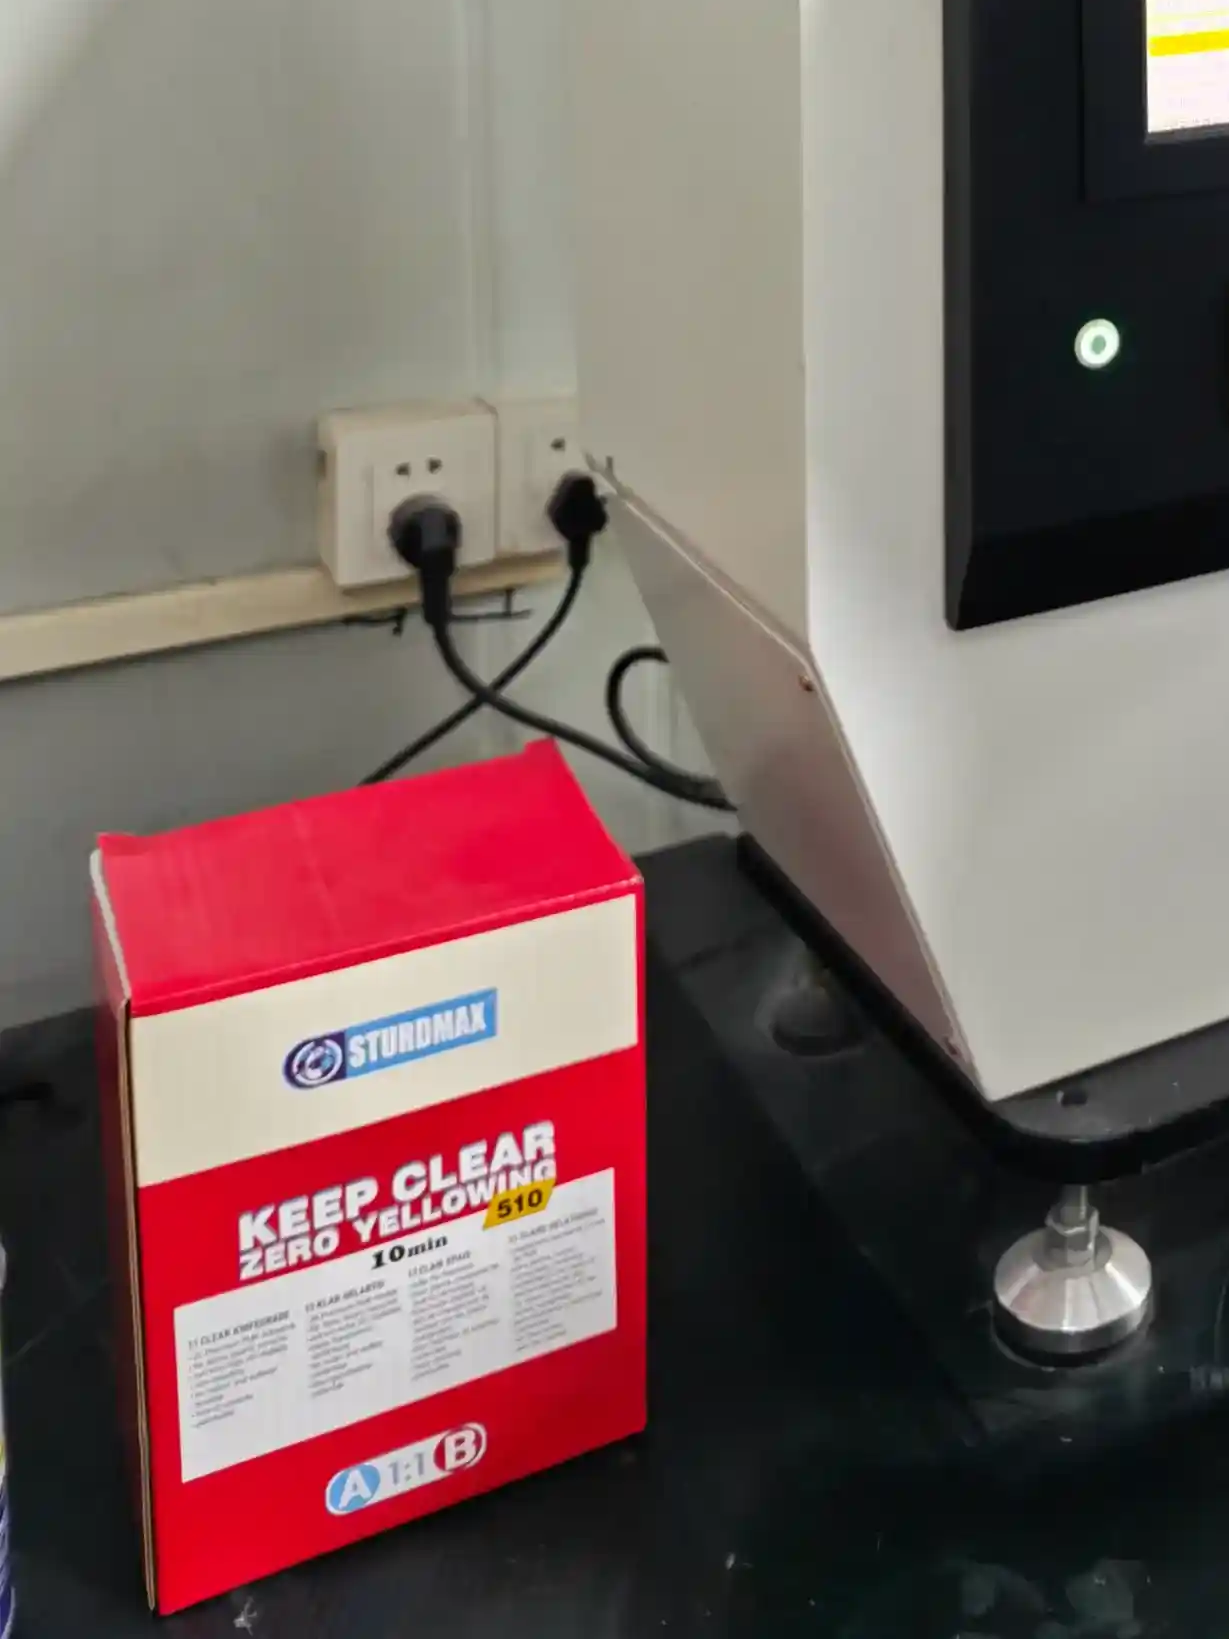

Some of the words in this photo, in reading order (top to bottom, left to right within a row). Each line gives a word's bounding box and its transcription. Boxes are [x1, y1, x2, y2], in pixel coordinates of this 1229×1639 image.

[349, 1001, 488, 1069] STURDMAX
[238, 1175, 379, 1253] KEEP
[391, 1119, 557, 1203] CLEAR
[238, 1226, 341, 1282] ZERO
[351, 1157, 558, 1244] YELLOWING
[496, 1188, 543, 1220] 510
[370, 1234, 448, 1270] 10min
[338, 1468, 373, 1510] A
[388, 1451, 426, 1486] 1:1
[444, 1428, 477, 1472] B
